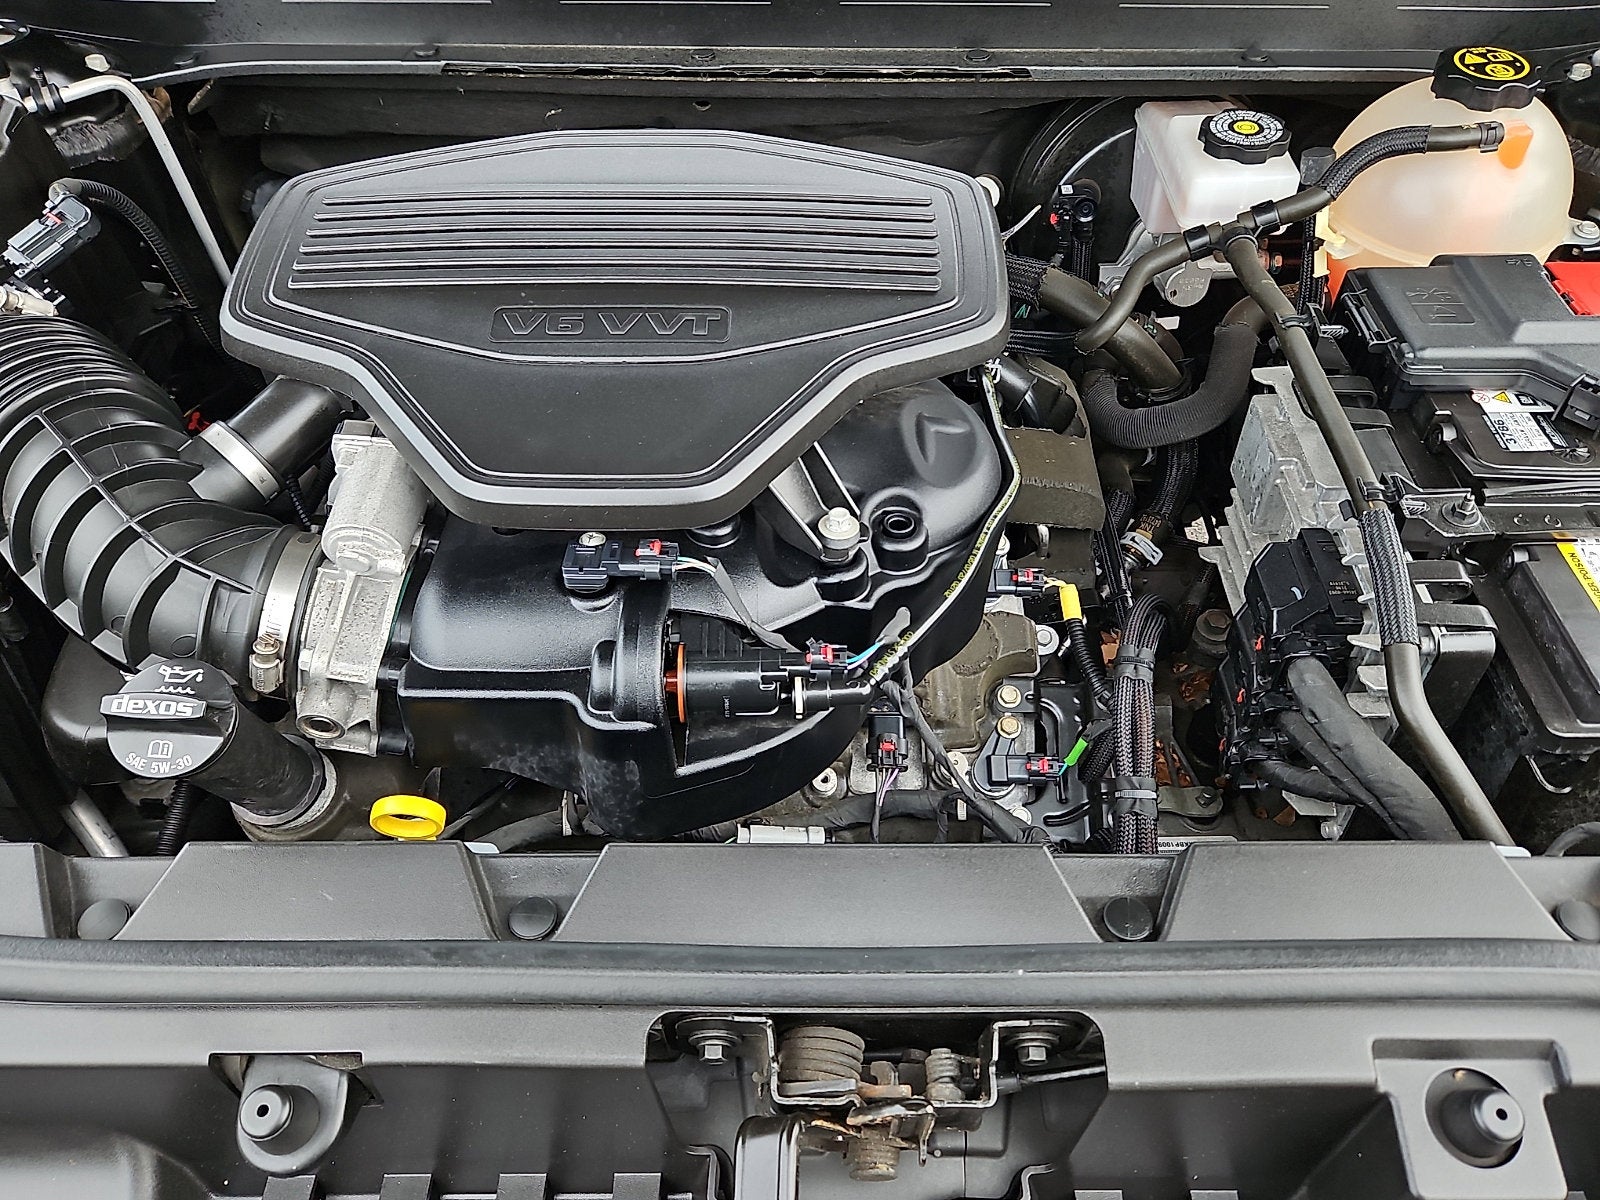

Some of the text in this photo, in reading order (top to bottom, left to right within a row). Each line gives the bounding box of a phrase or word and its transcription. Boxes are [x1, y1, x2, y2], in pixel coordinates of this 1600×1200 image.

[502, 312, 721, 335] V6 VVT
[1493, 419, 1517, 445] 3786
[1568, 552, 1592, 580] POISON
[110, 694, 197, 716] dexos
[125, 752, 193, 774] SAE 5W-30
